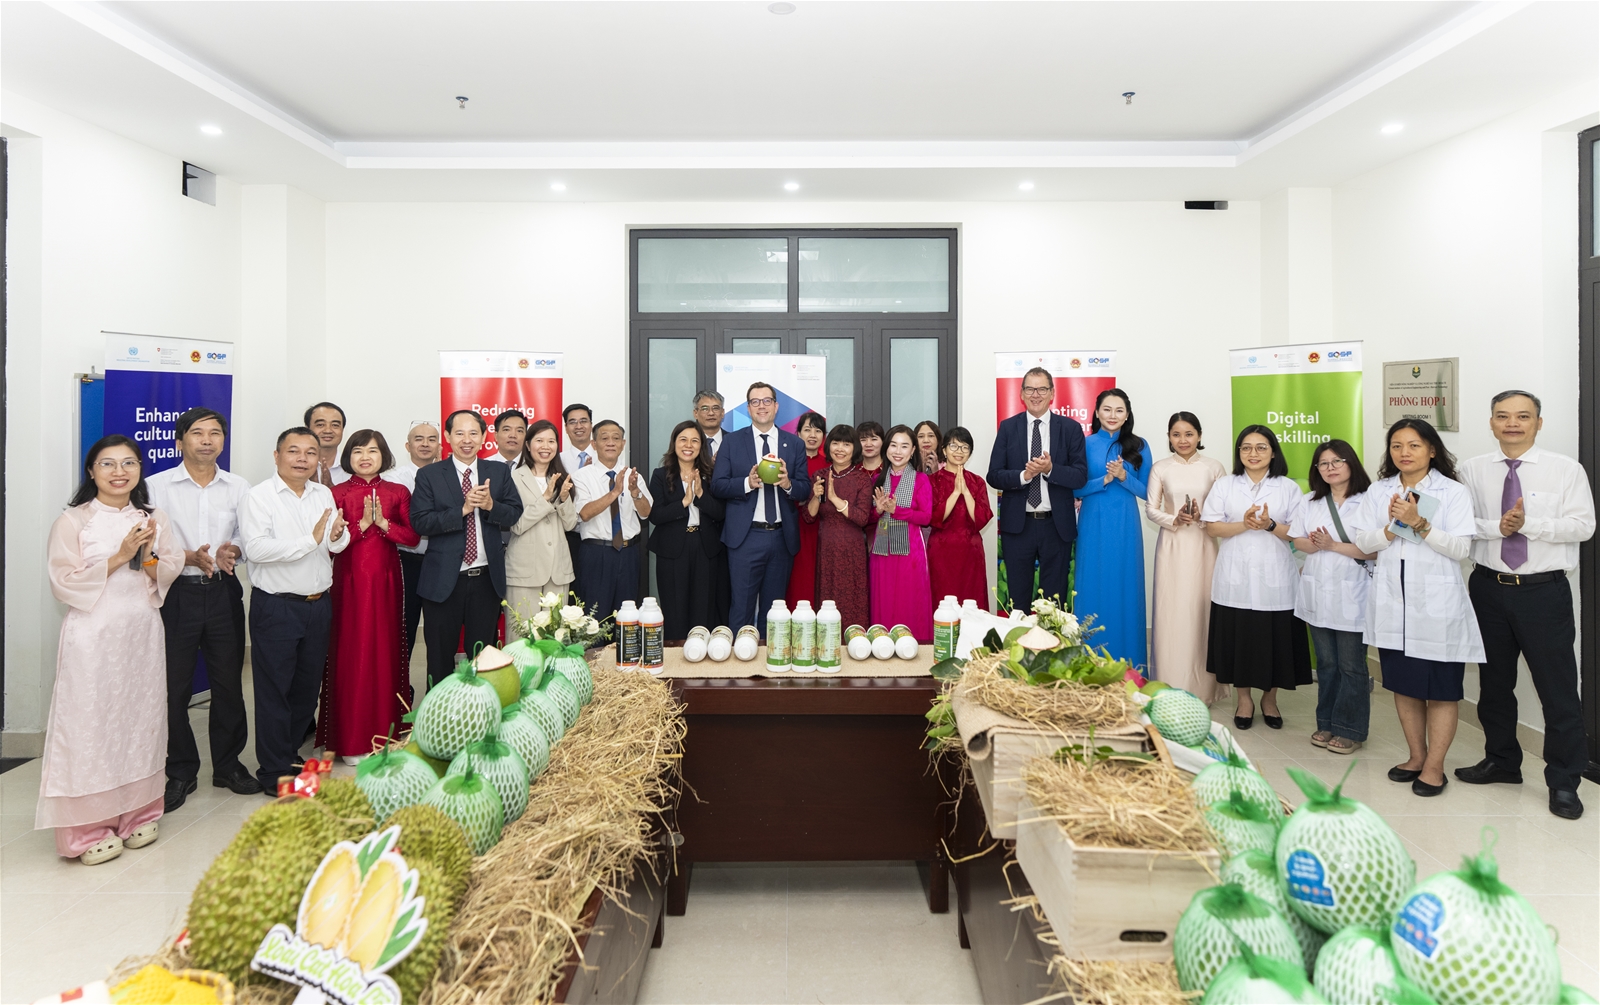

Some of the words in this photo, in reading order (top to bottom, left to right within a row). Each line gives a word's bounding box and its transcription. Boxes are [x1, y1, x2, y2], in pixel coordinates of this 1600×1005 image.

[1389, 394, 1418, 406] PHÒNG
[1420, 396, 1440, 409] HỌP
[1442, 396, 1446, 406] 1
[136, 407, 192, 422] Enhan
[471, 404, 535, 419] Redung
[1267, 411, 1319, 428] Digital
[134, 425, 176, 442] cultur
[1275, 430, 1331, 443] skilling
[148, 447, 181, 463] quali
